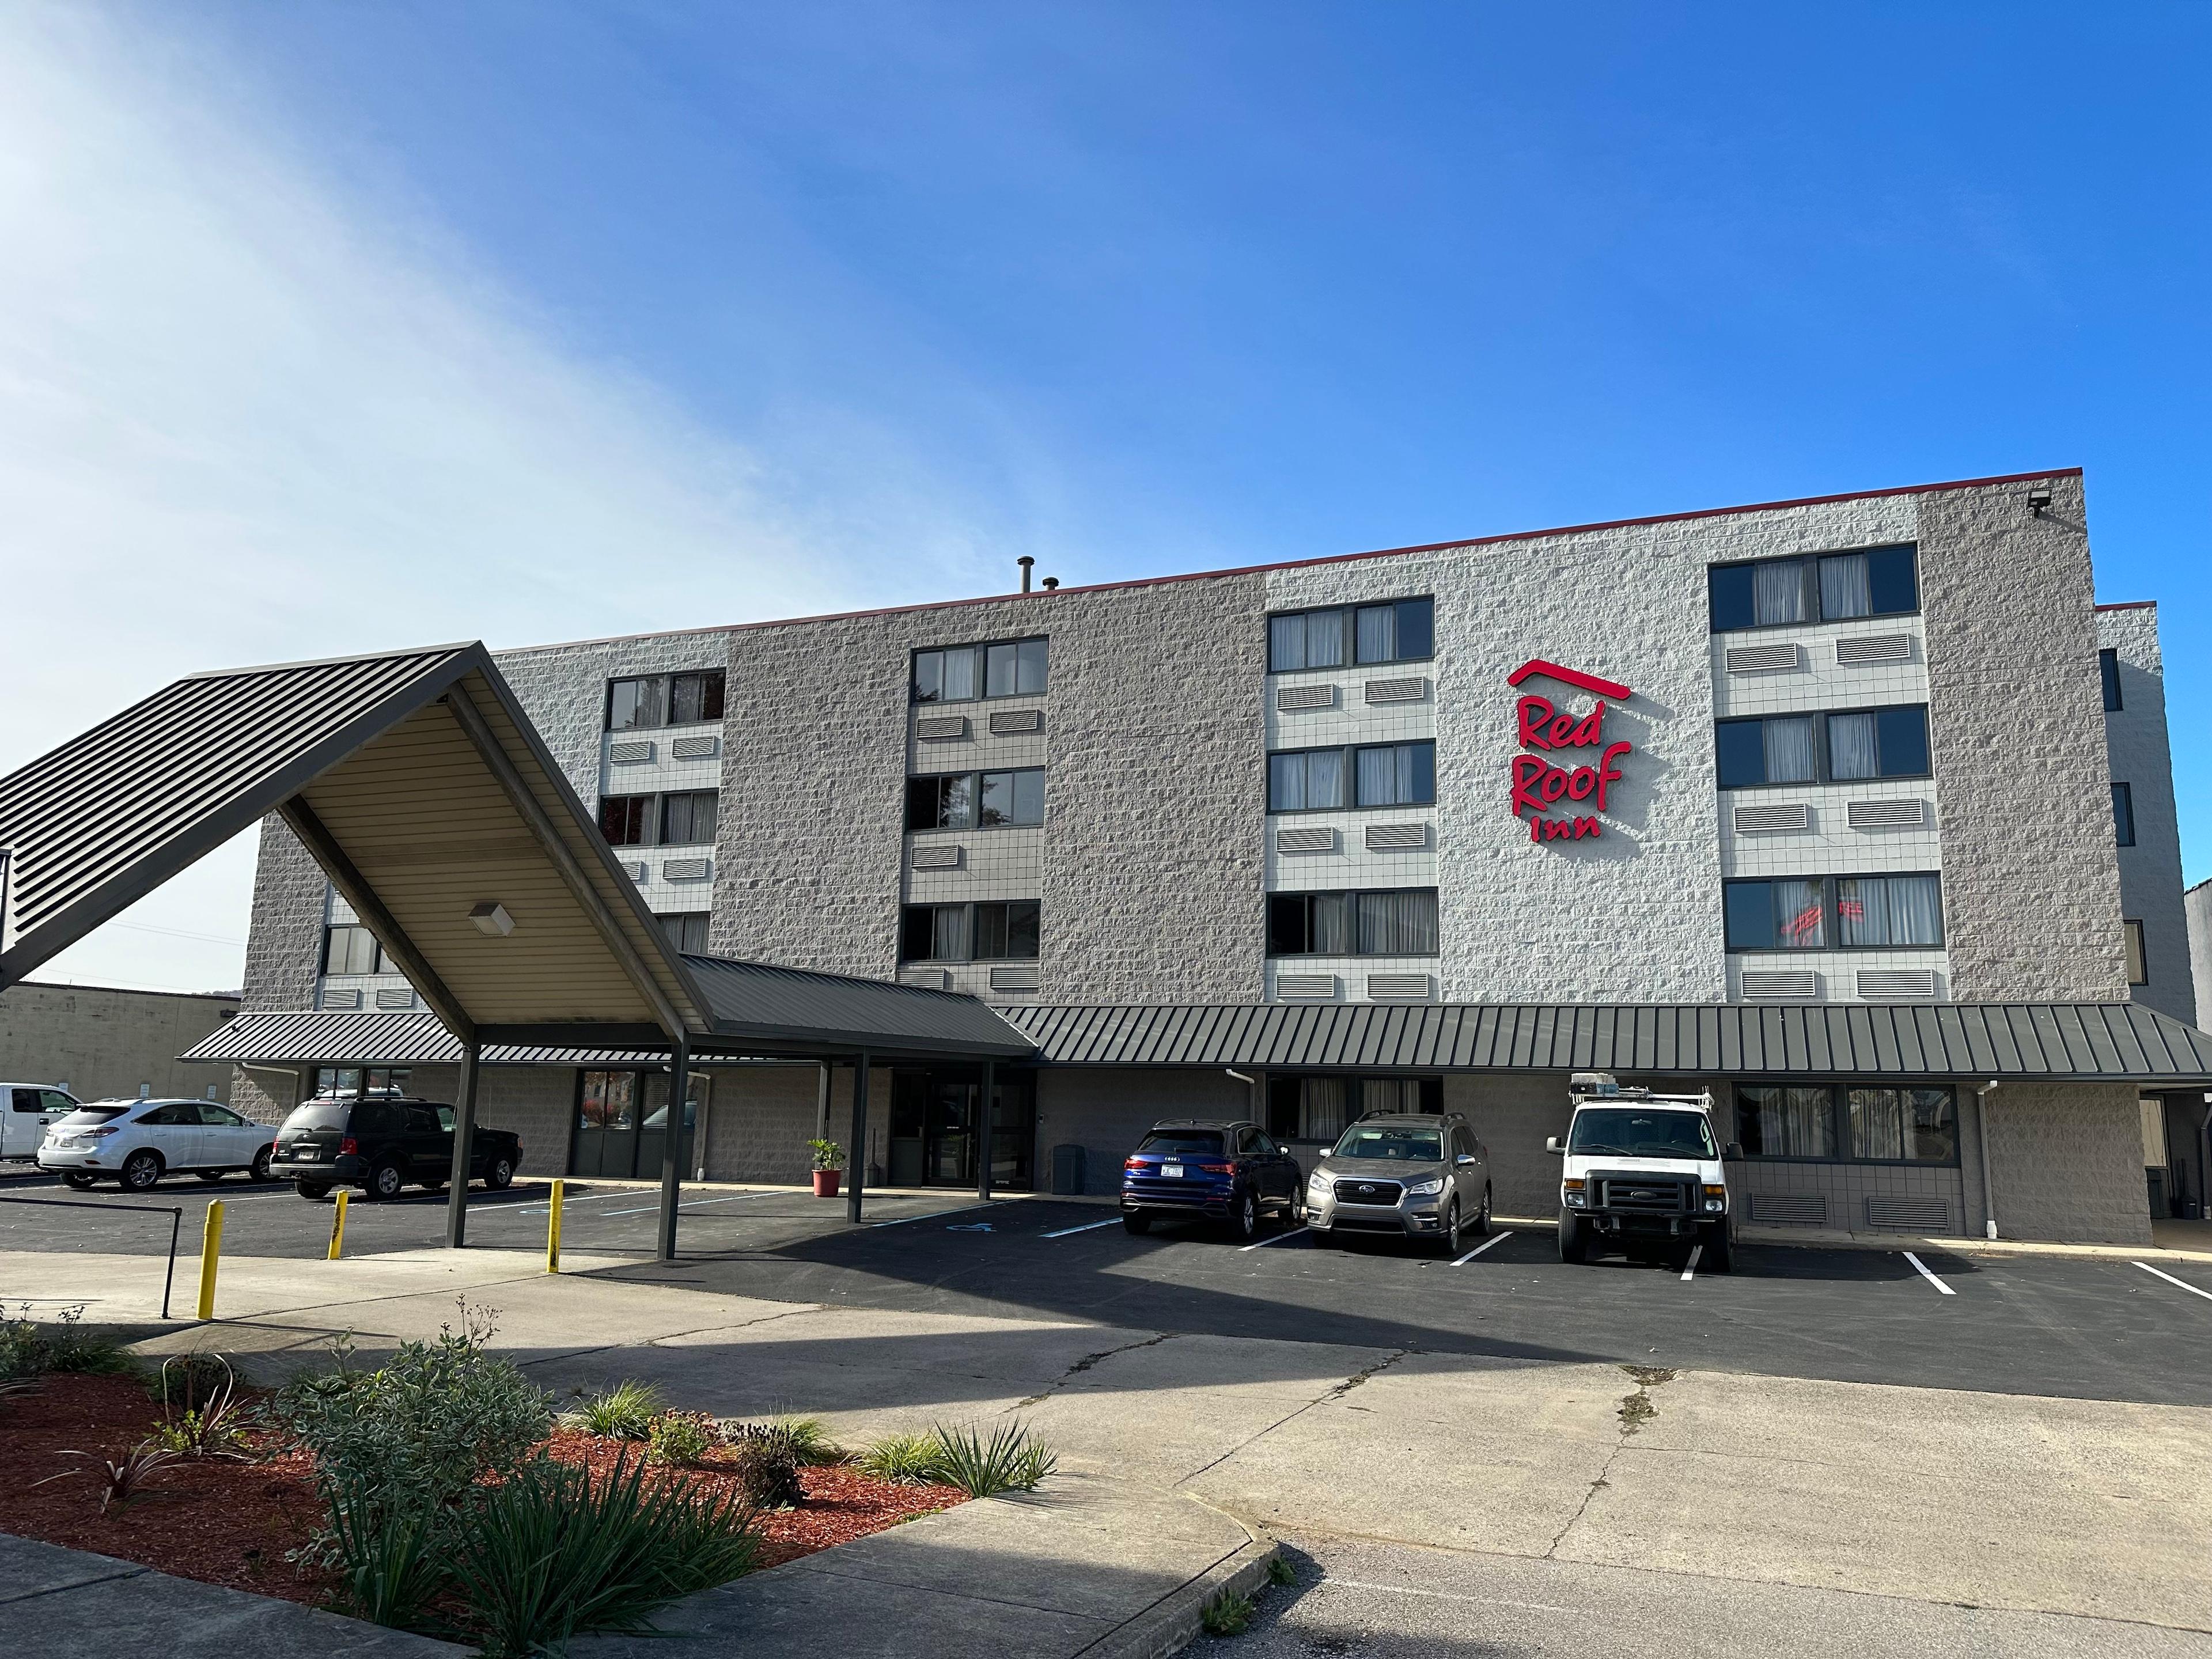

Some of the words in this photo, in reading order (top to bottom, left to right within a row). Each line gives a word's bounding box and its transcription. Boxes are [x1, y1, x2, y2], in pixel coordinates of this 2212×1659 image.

[1517, 695, 1606, 751] Red
[1510, 741, 1631, 816] Roof
[1531, 816, 1601, 842] Inn
